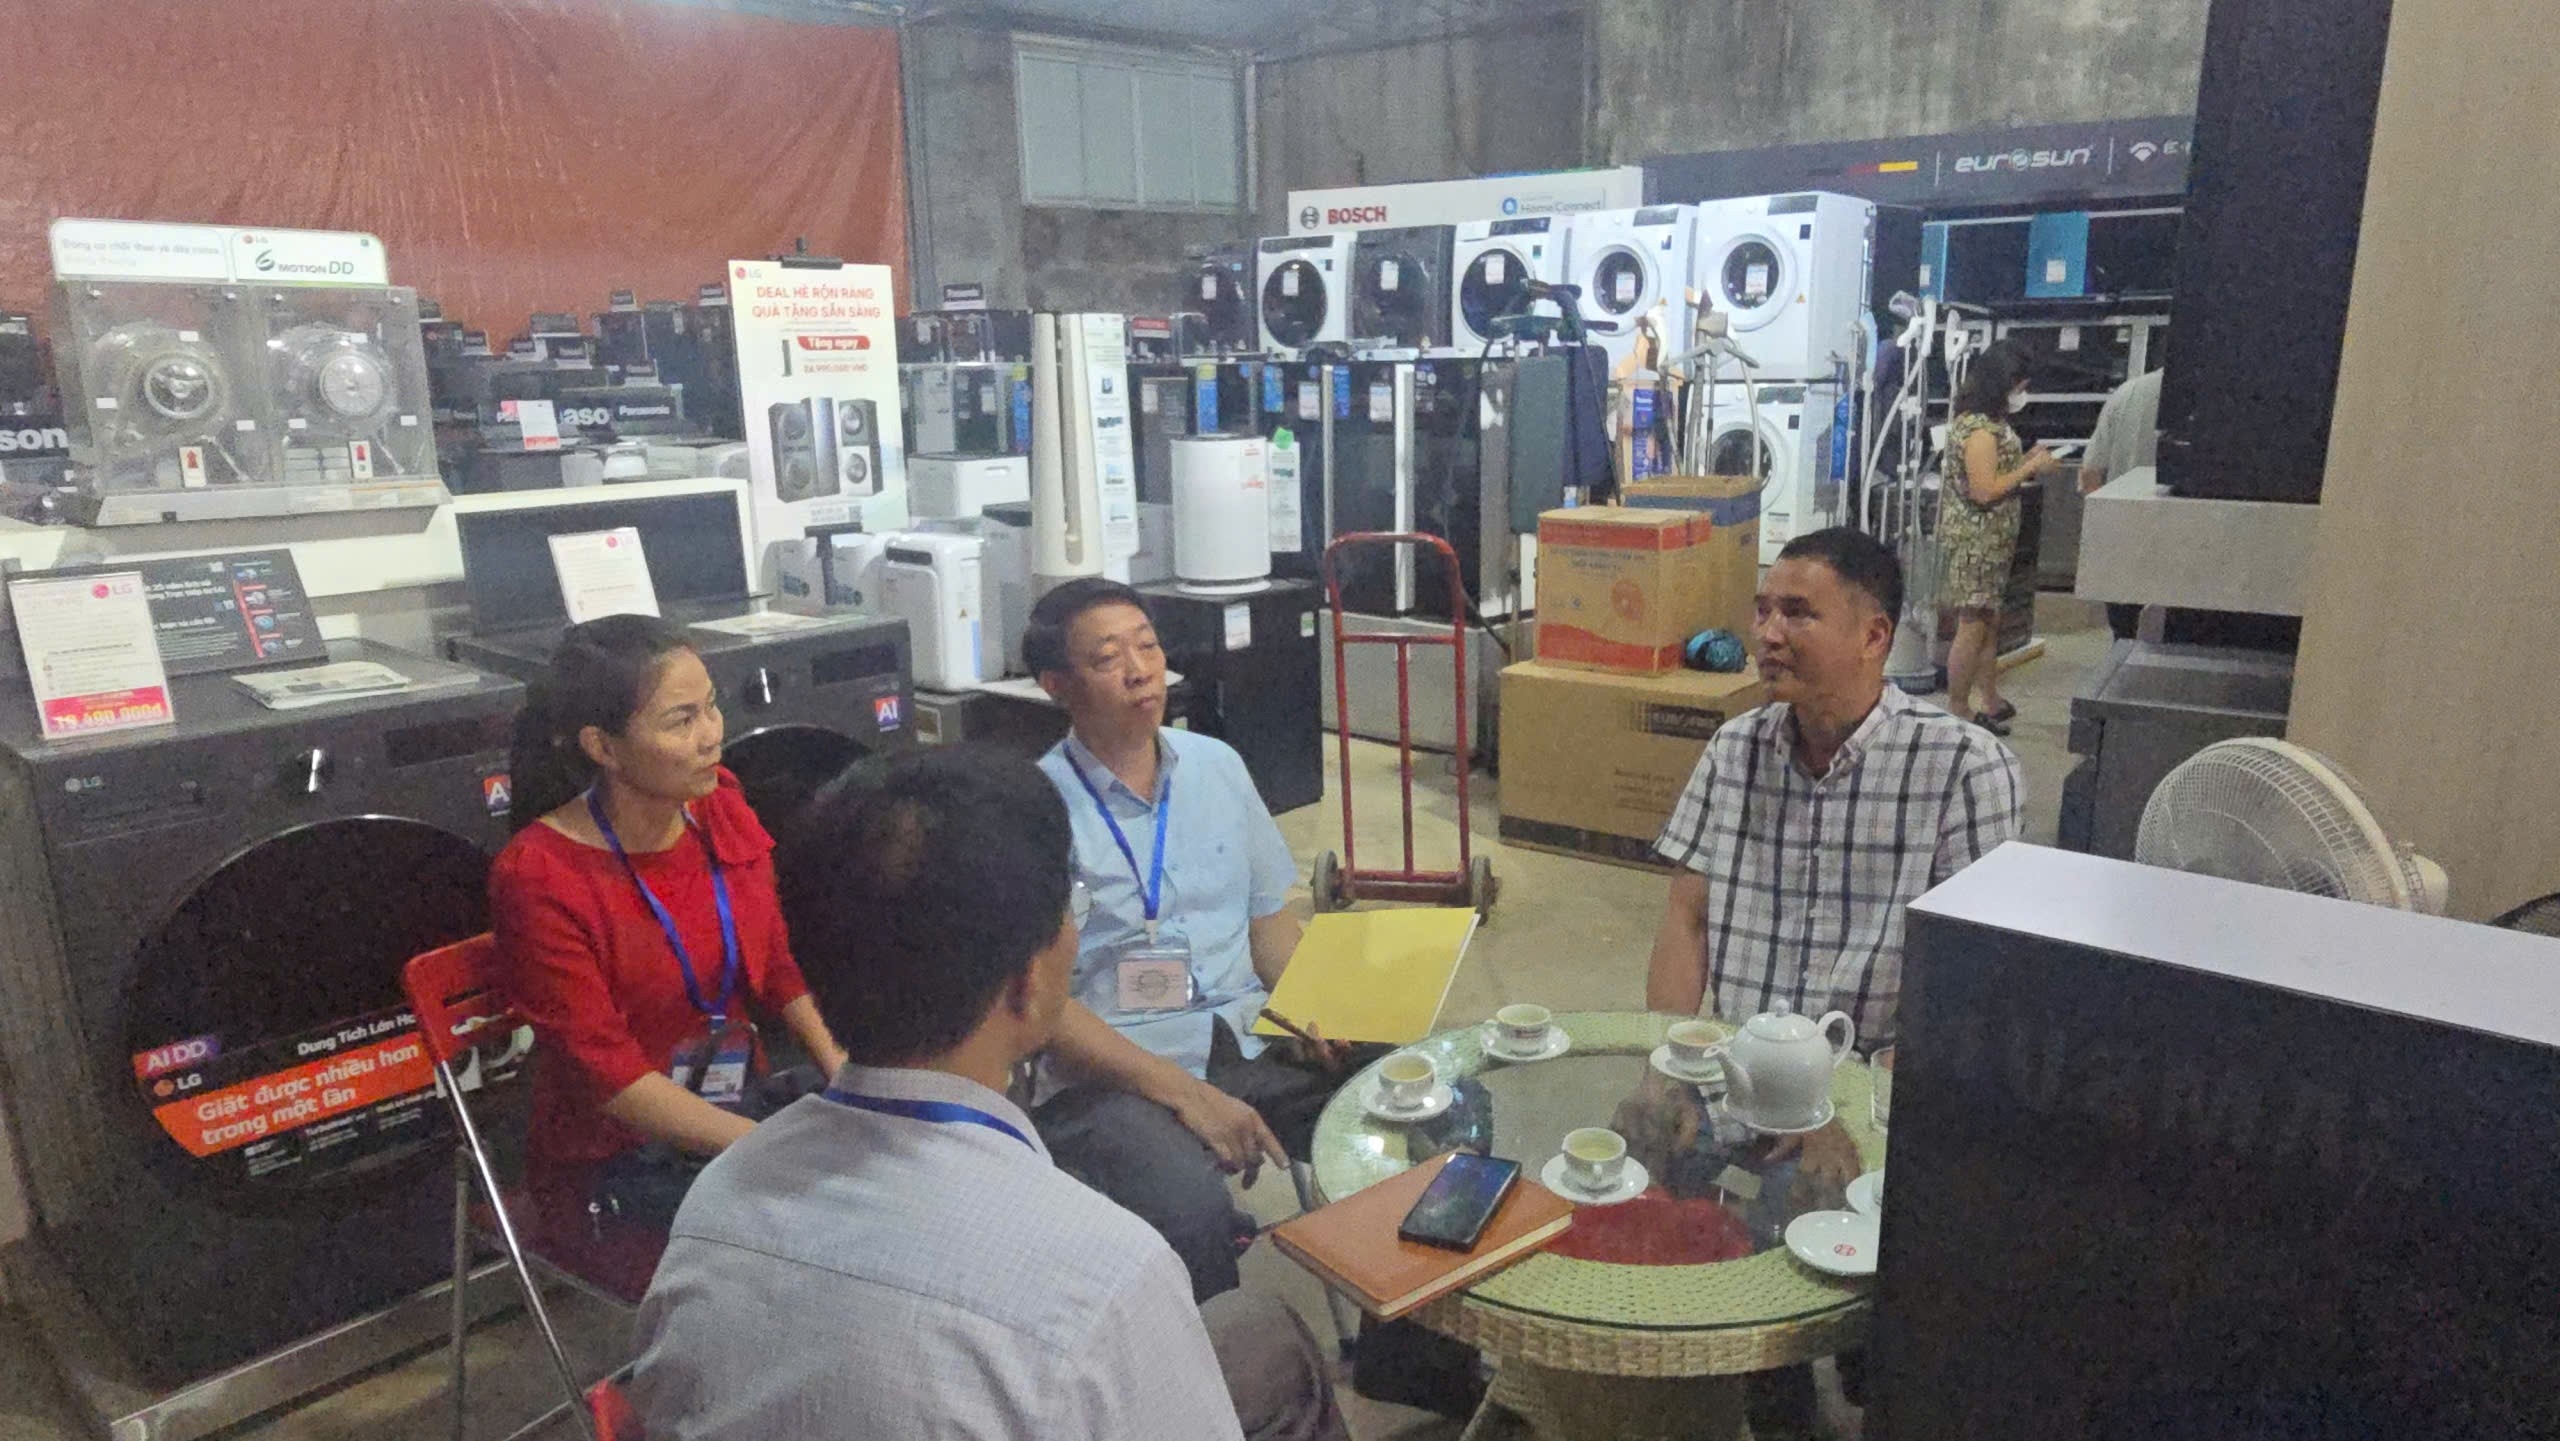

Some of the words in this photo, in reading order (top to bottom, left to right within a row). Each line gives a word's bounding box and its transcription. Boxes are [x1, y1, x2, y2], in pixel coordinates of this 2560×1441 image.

[1327, 206, 1387, 225] BOSCH
[279, 263, 327, 273] MOTION
[329, 261, 354, 274] DD
[757, 286, 790, 299] DEAL
[561, 407, 610, 425] aso
[619, 405, 670, 415] Panasonic
[0, 428, 68, 451] son
[112, 583, 134, 596] LG
[878, 700, 898, 721] AI
[83, 775, 103, 788] LG
[488, 782, 511, 805] A
[297, 1037, 336, 1055] Dung
[338, 1026, 367, 1044] Tích
[147, 1053, 171, 1072] AI
[172, 1041, 208, 1063] DD
[177, 1073, 203, 1090] LG
[198, 1094, 249, 1121] Giặt
[254, 1076, 311, 1105] được
[315, 1056, 375, 1086] nhiều
[379, 1043, 419, 1067] hơn
[201, 1114, 268, 1145] trong
[272, 1097, 319, 1125] một
[321, 1086, 356, 1109] lần
